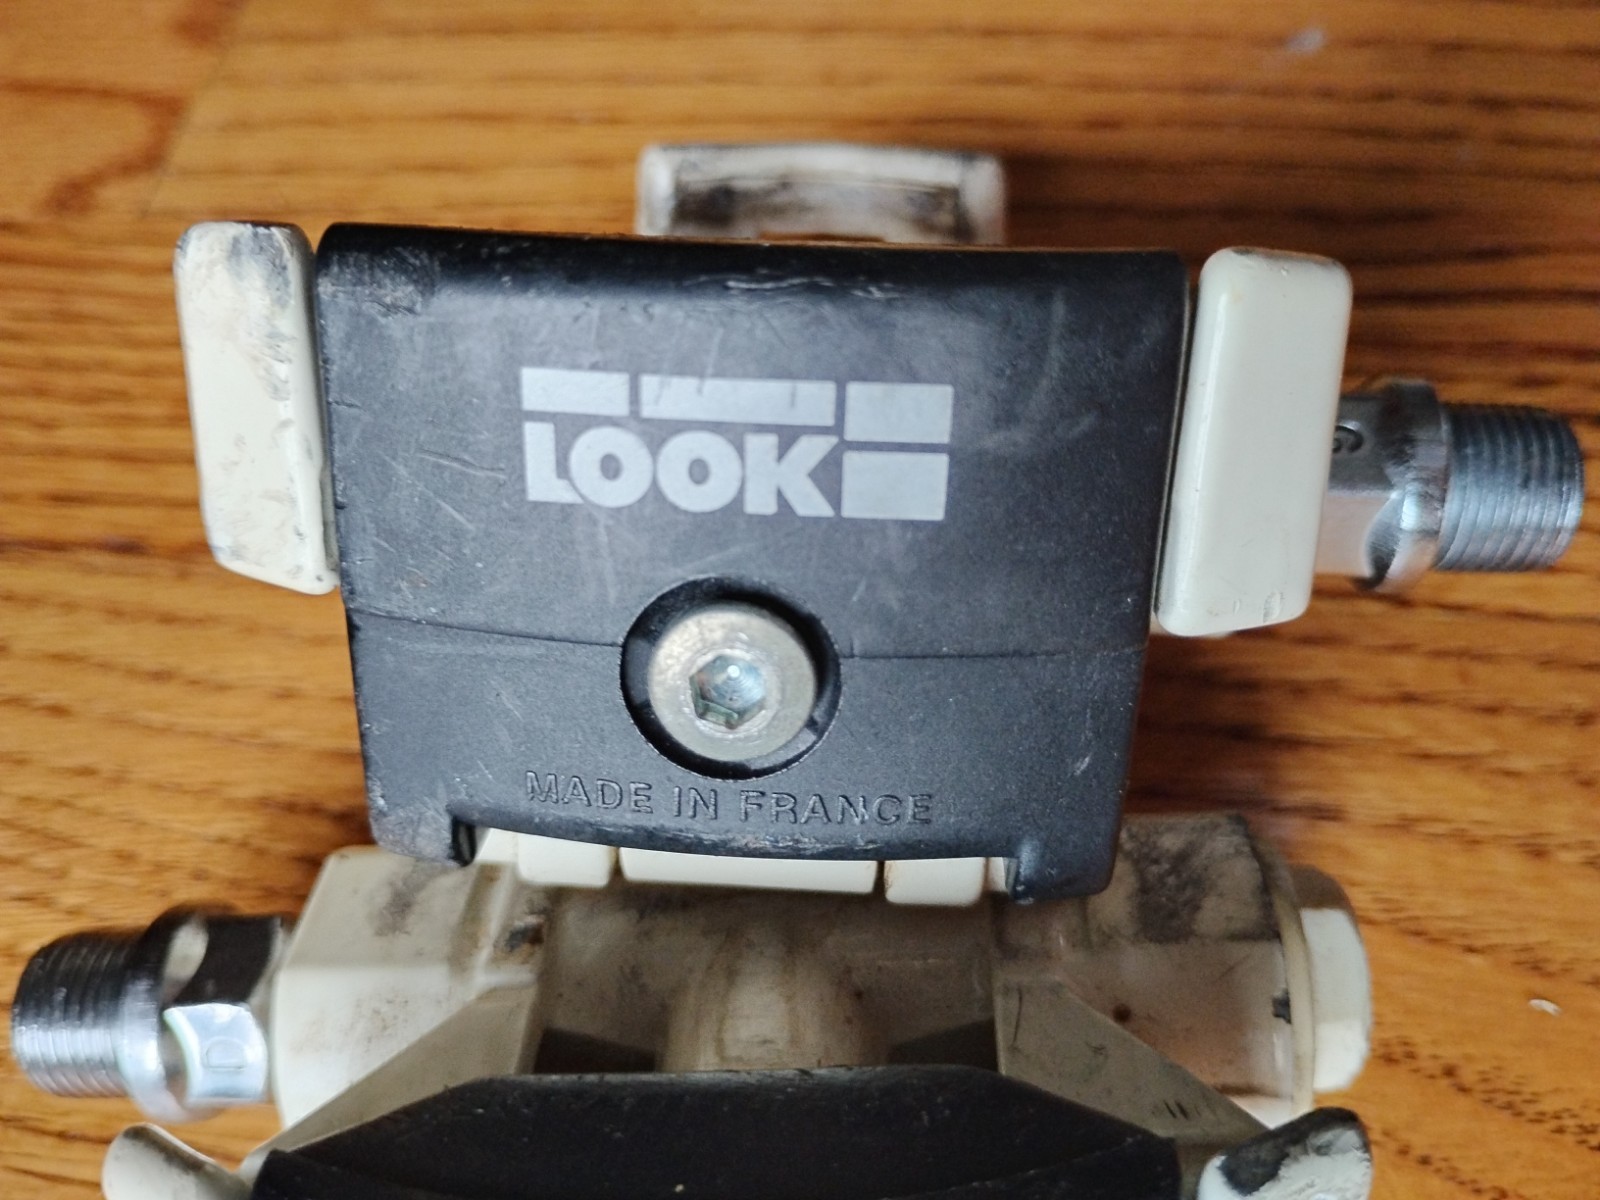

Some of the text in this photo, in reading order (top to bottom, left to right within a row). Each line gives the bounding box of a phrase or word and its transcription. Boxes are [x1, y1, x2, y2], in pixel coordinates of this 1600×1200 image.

[523, 420, 840, 518] LOOK
[525, 771, 933, 826] MADE IN FRANCE
